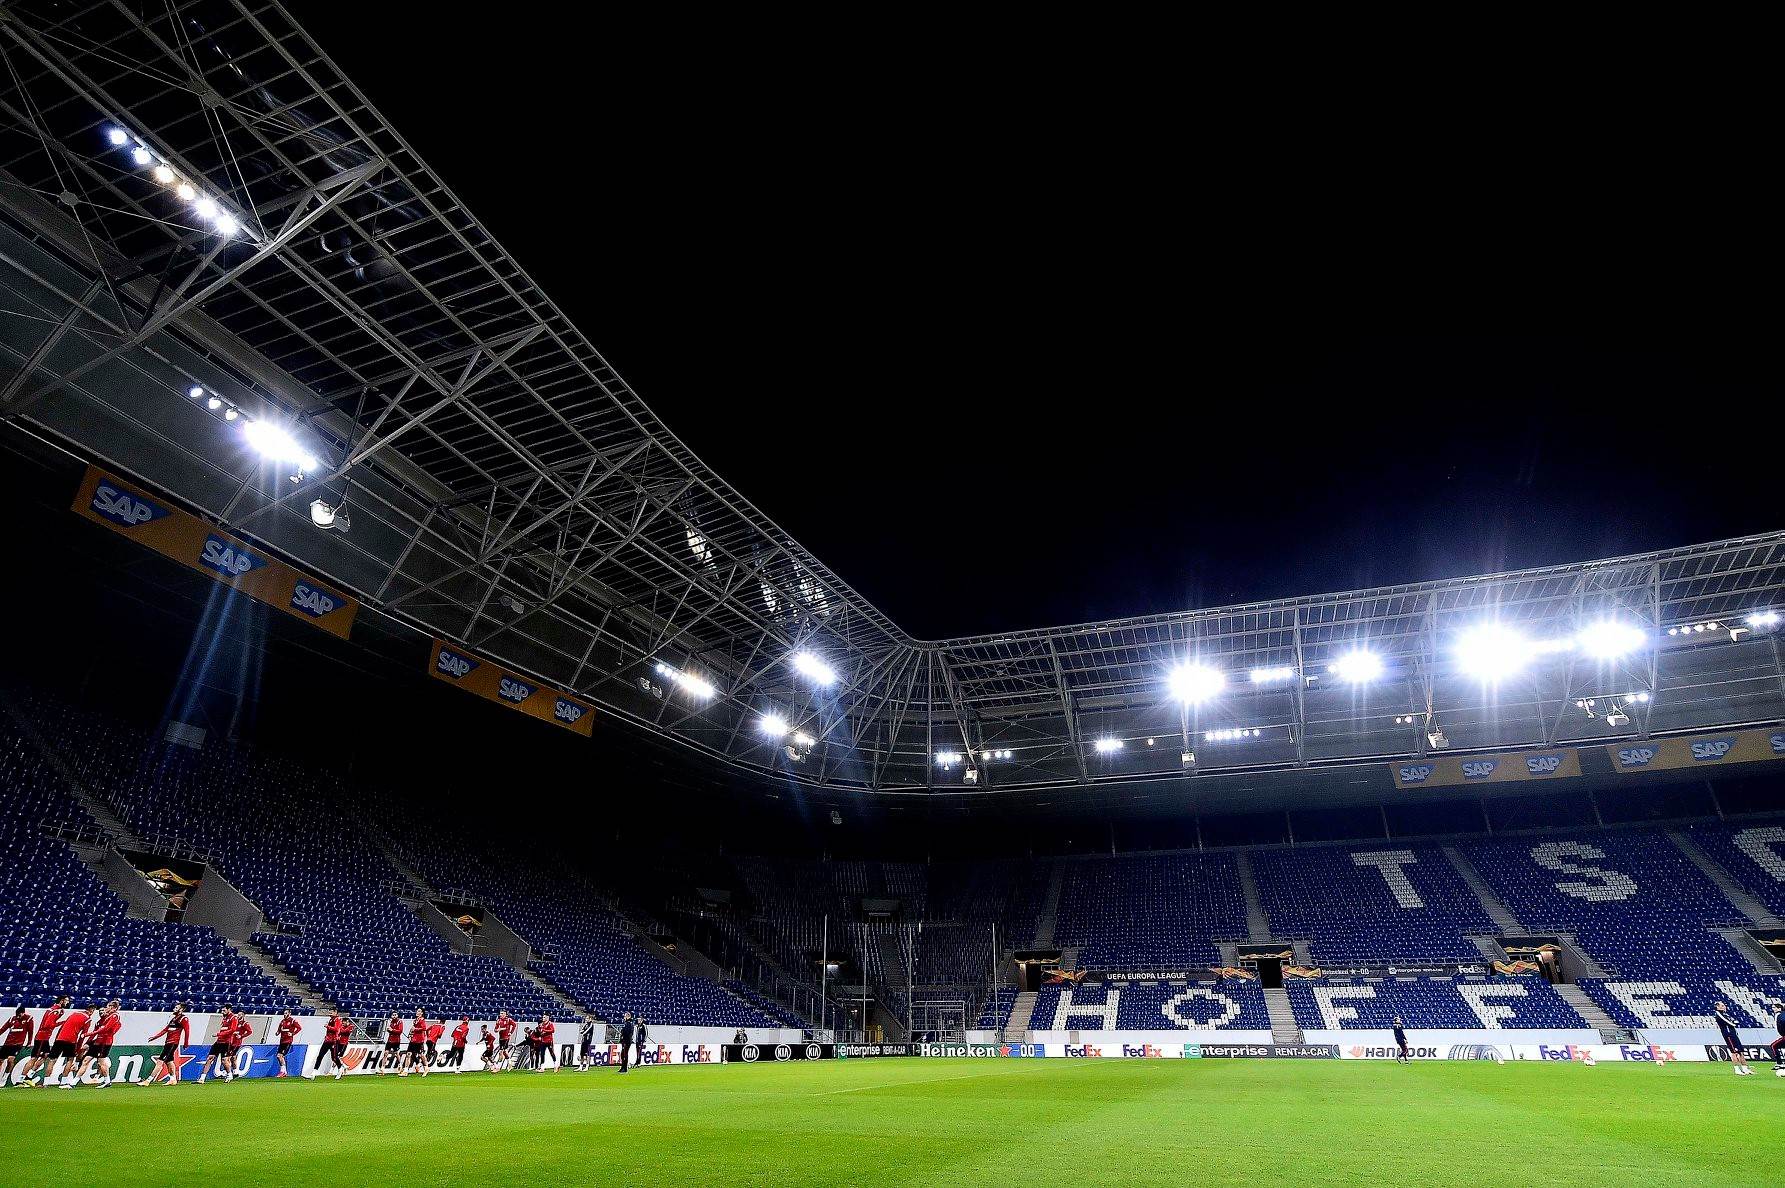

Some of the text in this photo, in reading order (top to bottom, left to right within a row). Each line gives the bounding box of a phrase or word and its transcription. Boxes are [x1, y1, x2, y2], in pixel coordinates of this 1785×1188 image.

[93, 486, 153, 525] SAP
[201, 540, 251, 574] SAP
[292, 585, 334, 615] SAP
[438, 651, 470, 677] SAP
[500, 678, 529, 701] SAP
[555, 701, 581, 722] SAP
[1618, 749, 1654, 765] SAP
[1690, 741, 1730, 758] SAP
[1462, 762, 1495, 777] SAP
[1527, 757, 1560, 772] SAP
[1400, 766, 1430, 781] SAP
[1458, 965, 1486, 973] FedEx
[641, 1045, 672, 1064] FedEx
[682, 1045, 712, 1063] FedEx
[744, 1047, 757, 1058] KIA
[776, 1047, 790, 1058] KIA
[807, 1046, 820, 1057] KIA
[839, 1043, 906, 1058] enterprise RENT-A-CAR
[920, 1044, 997, 1057] Heineken
[1064, 1044, 1102, 1058] FedEx
[1123, 1044, 1162, 1059] FedEx
[1188, 1045, 1330, 1058] enterprise RENT-A-CAR
[1539, 1045, 1592, 1060] FedEx
[1620, 1045, 1677, 1060] FedEx
